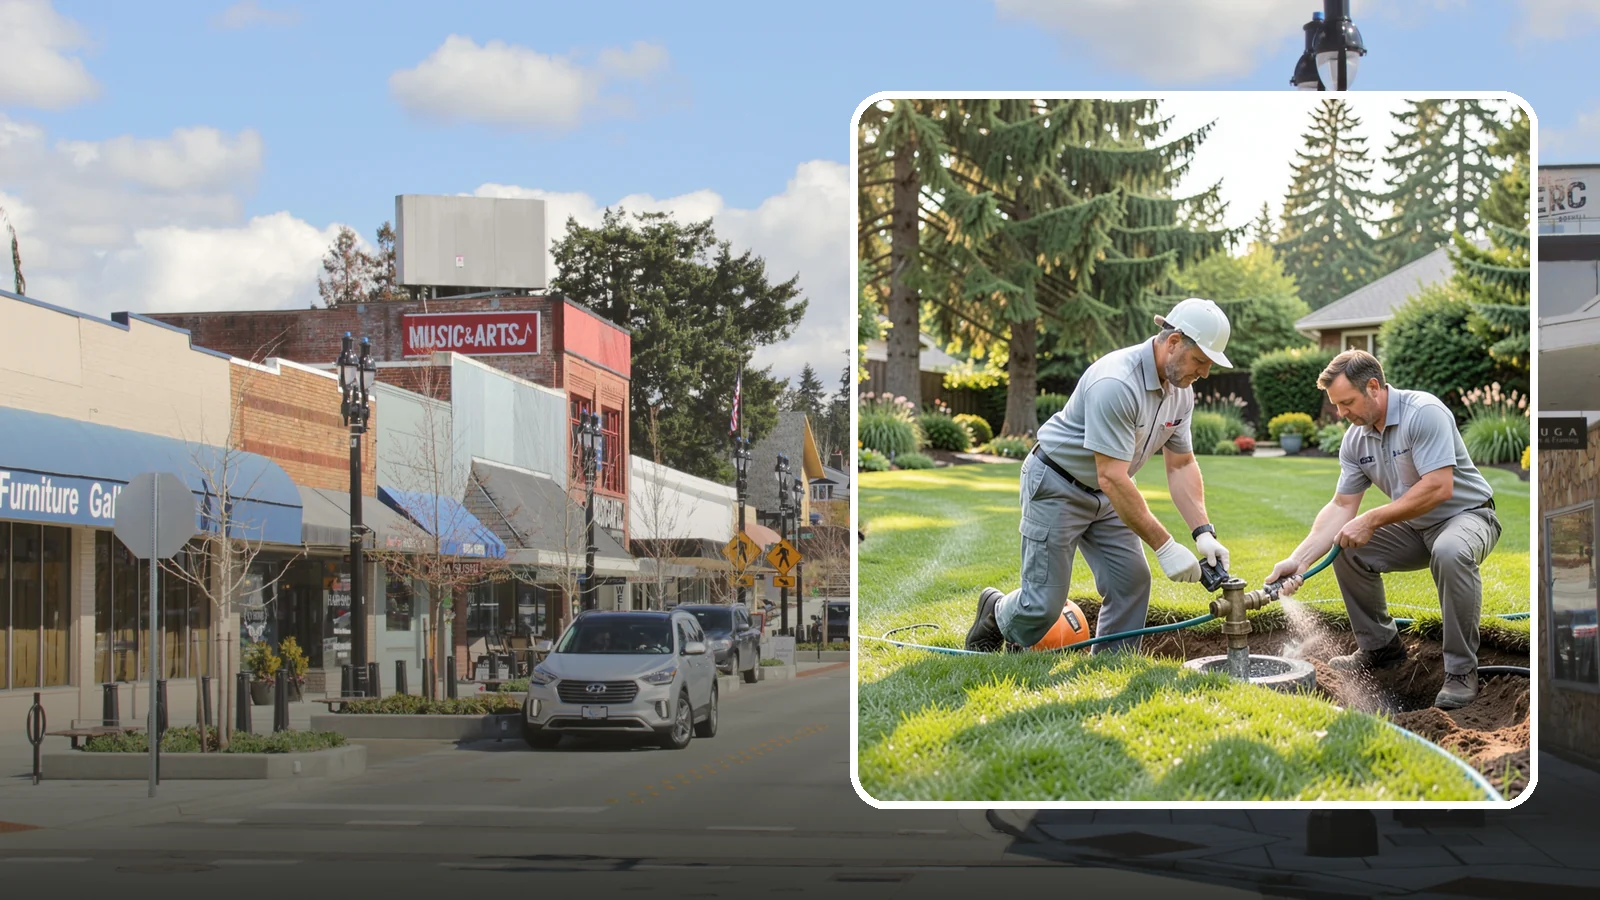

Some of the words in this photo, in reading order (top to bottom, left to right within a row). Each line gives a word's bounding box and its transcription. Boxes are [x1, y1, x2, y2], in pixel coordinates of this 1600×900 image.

[1540, 427, 1577, 436] UGA
[0, 471, 79, 515] Furniture
[89, 482, 121, 519] Gal
[453, 563, 479, 574] SUSHI
